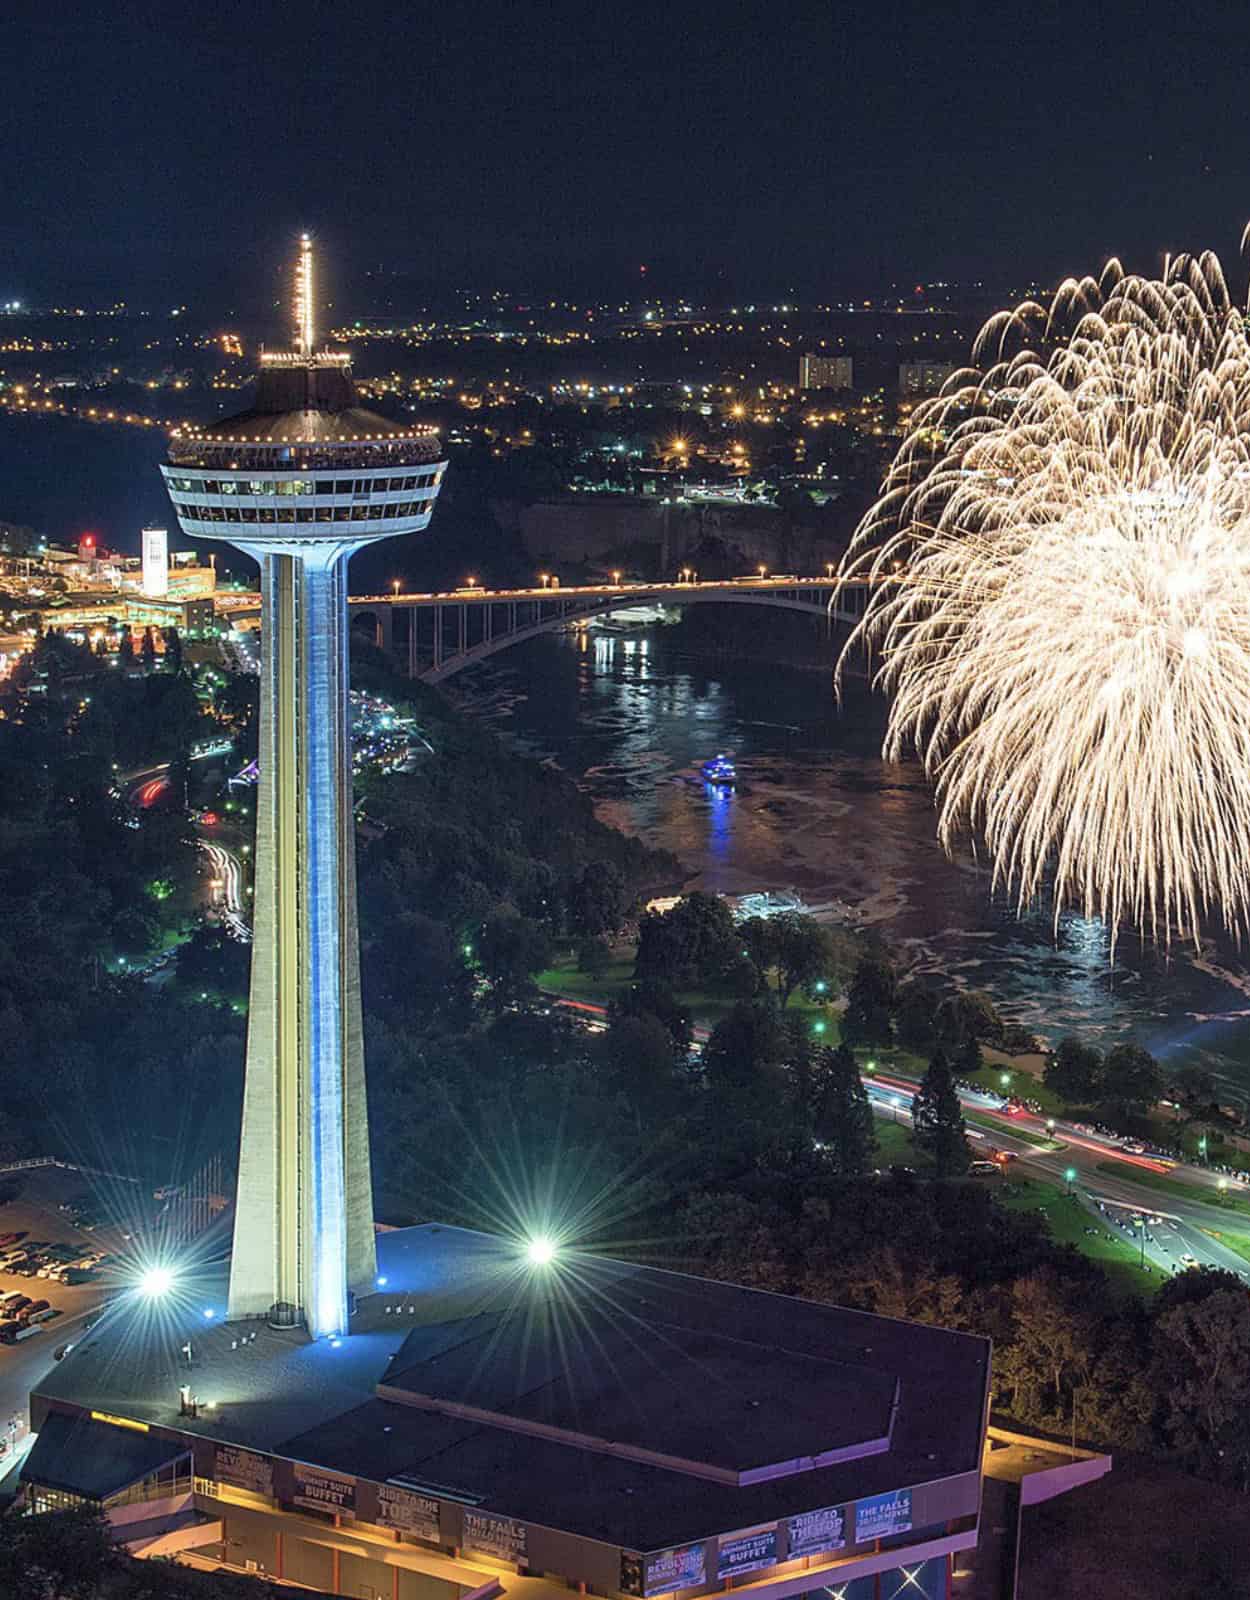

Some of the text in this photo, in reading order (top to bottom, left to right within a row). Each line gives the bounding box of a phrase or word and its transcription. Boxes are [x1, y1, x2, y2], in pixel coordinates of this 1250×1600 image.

[305, 1485, 344, 1505] BUFFET
[330, 1482, 353, 1496] SUITE
[379, 1487, 400, 1502] RIDE
[419, 1498, 439, 1513] THE
[379, 1500, 412, 1520] TOP
[859, 1498, 909, 1519] THE FALLS
[465, 1513, 526, 1539] THE FALLS
[796, 1509, 838, 1528] RIDE TO
[753, 1535, 776, 1547] SUITE
[729, 1546, 767, 1563] BUFFET
